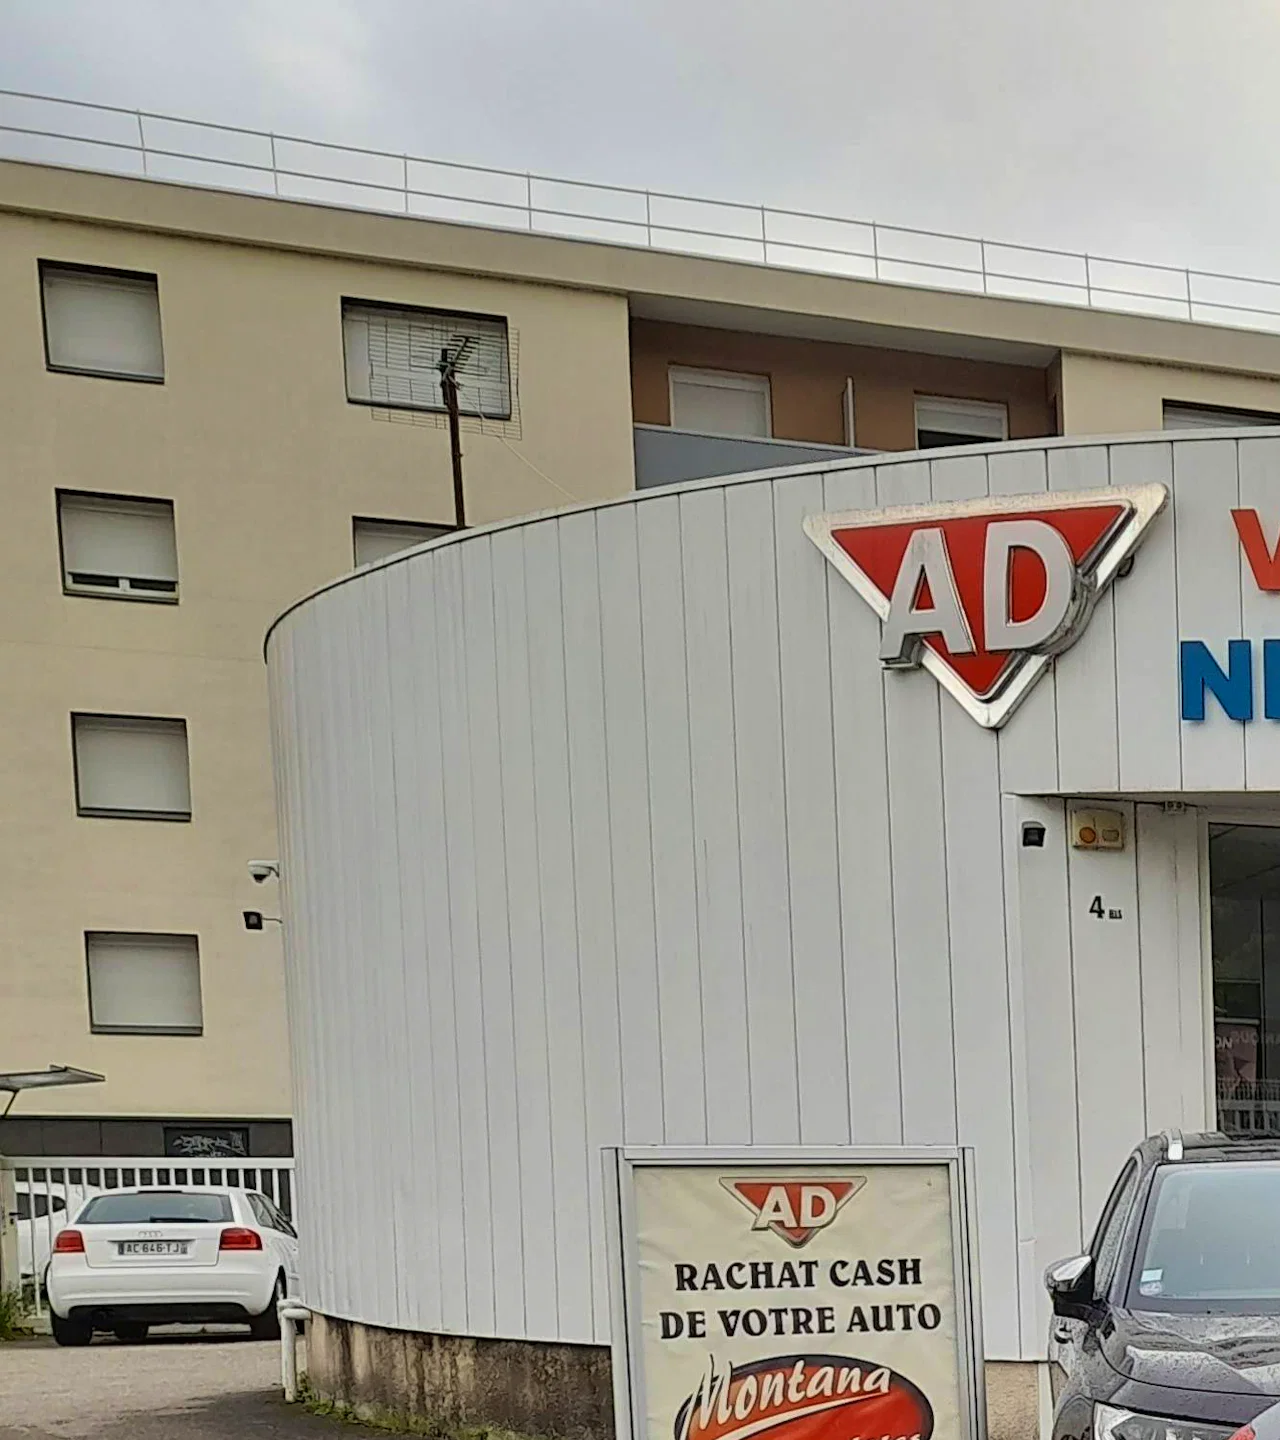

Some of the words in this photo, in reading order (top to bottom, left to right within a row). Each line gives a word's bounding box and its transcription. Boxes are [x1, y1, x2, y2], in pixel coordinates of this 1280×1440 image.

[879, 519, 1075, 661] AD
[1089, 895, 1105, 919] 4
[754, 1185, 838, 1229] AD
[675, 1260, 818, 1291] RACHAT
[829, 1258, 922, 1286] CASH
[659, 1310, 706, 1339] DE
[718, 1307, 835, 1338] VOTRE
[847, 1303, 941, 1334] AUTO
[680, 1354, 892, 1440] Montana
